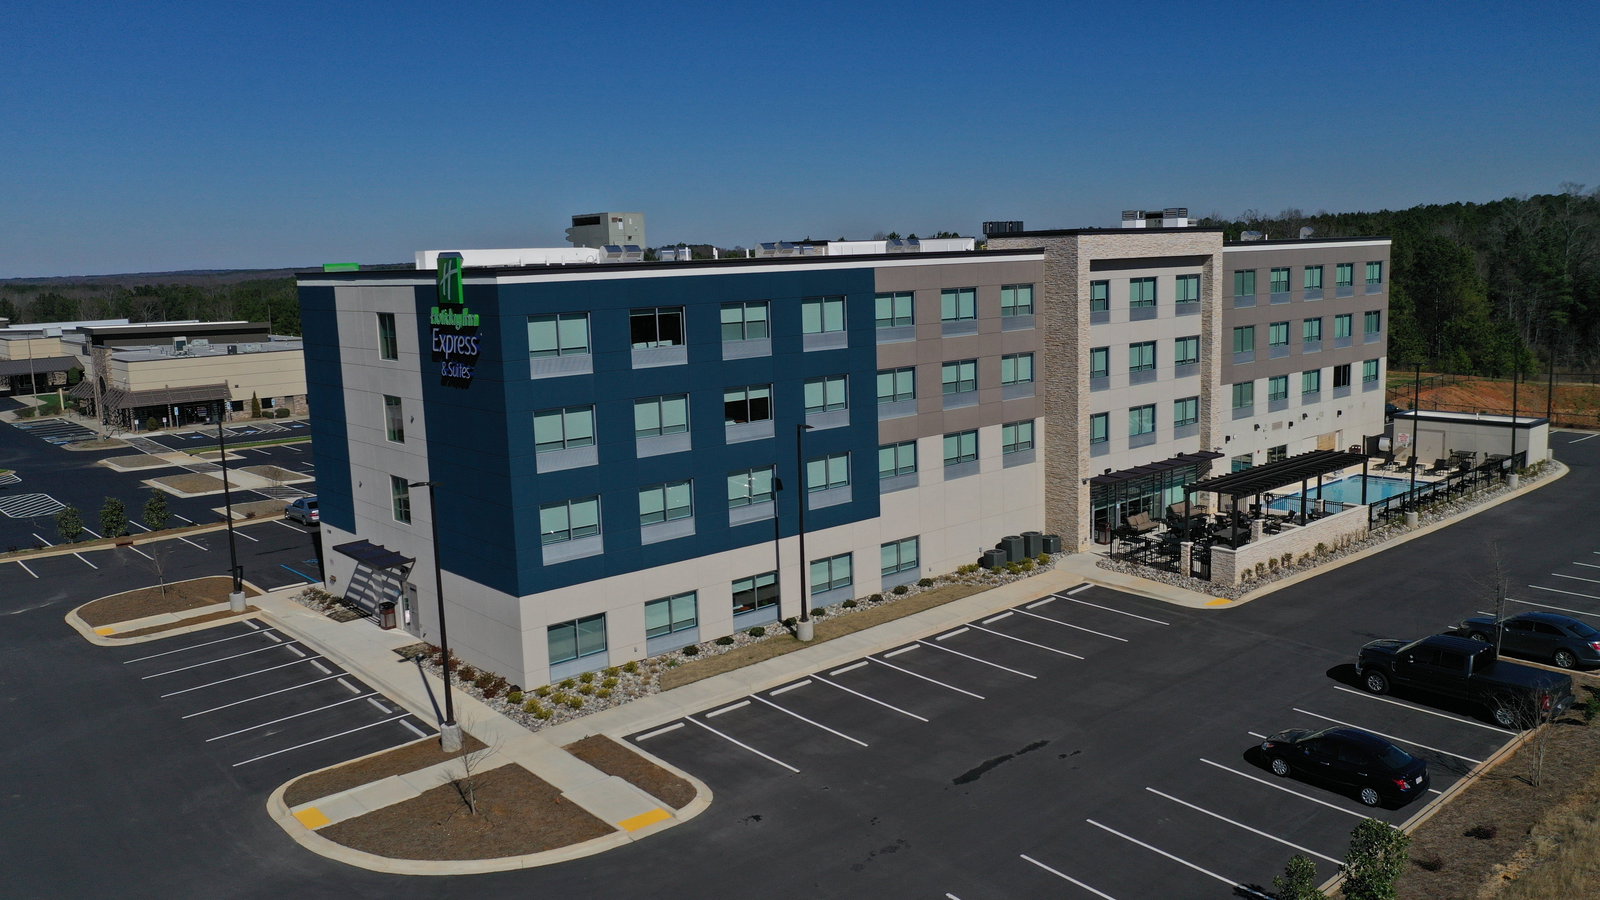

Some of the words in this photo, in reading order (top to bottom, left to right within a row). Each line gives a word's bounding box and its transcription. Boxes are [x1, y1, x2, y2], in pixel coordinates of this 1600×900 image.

[432, 328, 478, 359] Express
[441, 361, 447, 376] &
[448, 361, 470, 379] Suites
